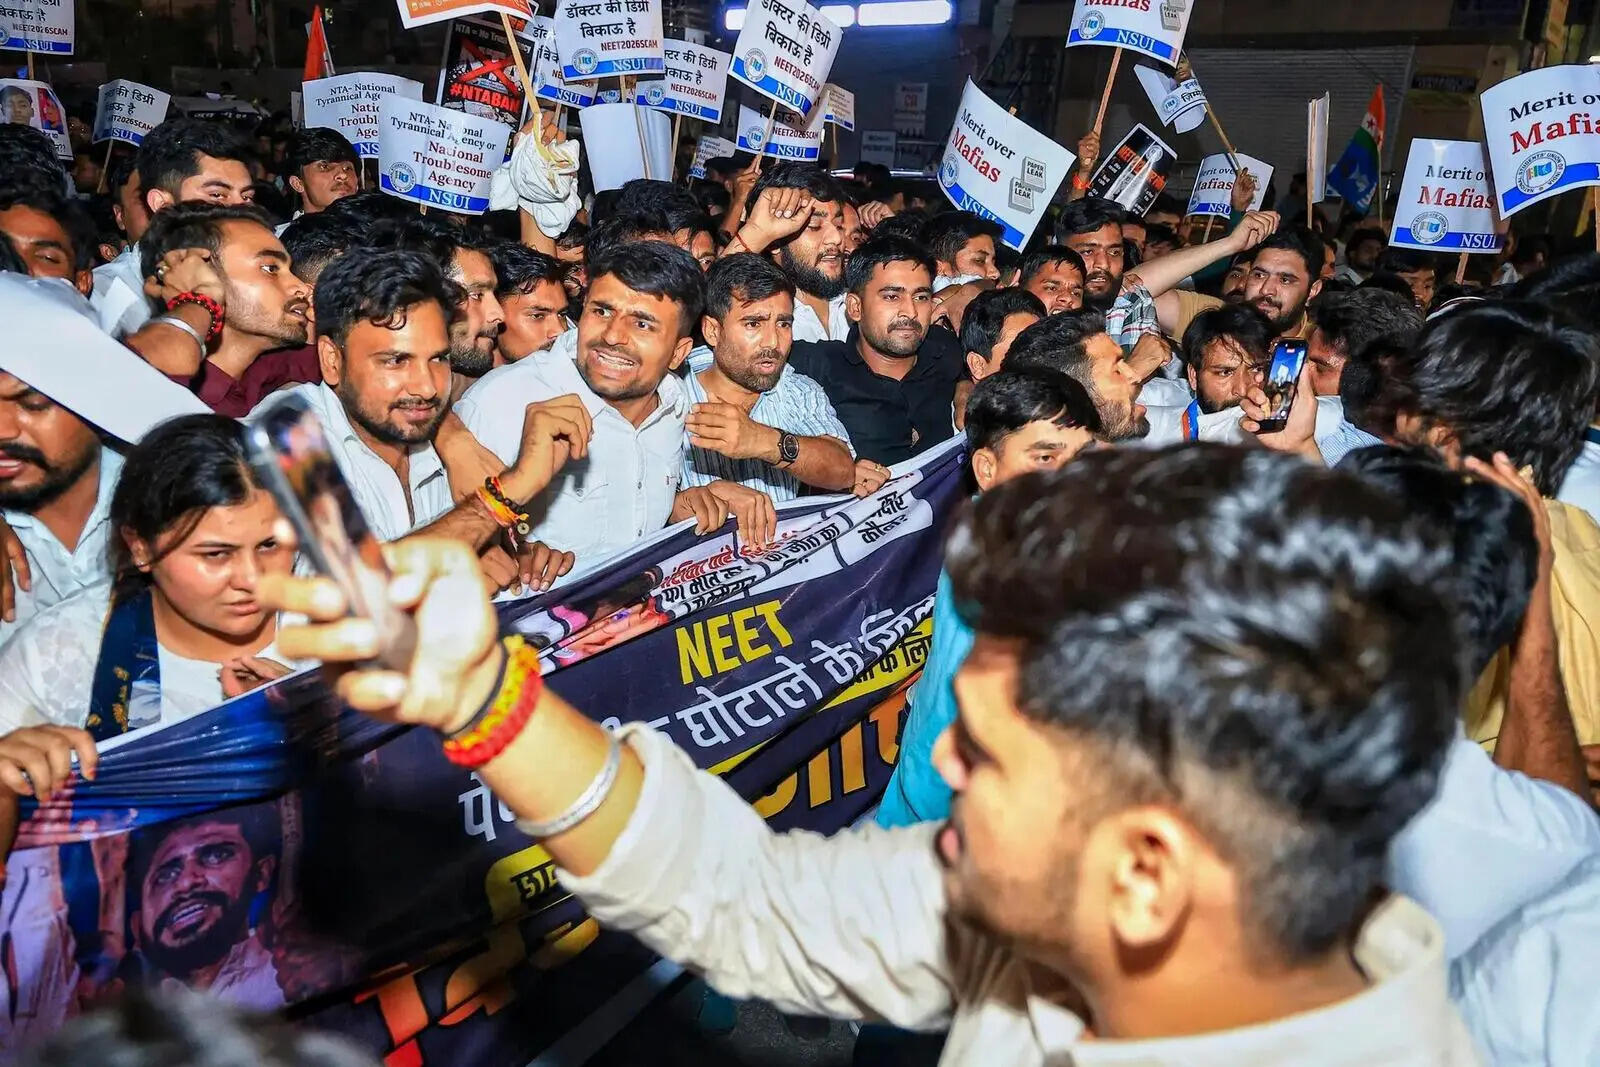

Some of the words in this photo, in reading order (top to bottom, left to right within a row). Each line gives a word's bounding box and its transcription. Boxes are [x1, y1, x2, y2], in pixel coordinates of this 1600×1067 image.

[565, 1, 601, 18] डॉक्टर
[580, 22, 623, 38] बिकाऊ
[626, 18, 636, 35] है
[797, 14, 811, 35] की
[811, 22, 832, 50] डिग्री
[23, 39, 54, 51] NSUI
[601, 39, 658, 51] NEET2026SCAM
[764, 20, 803, 59] बिकाऊ
[803, 44, 814, 67] है
[1117, 30, 1156, 52] NSUI
[612, 57, 647, 71] NSUI
[683, 50, 697, 65] की
[698, 53, 718, 71] डिग्री
[695, 70, 704, 85] है
[774, 56, 820, 91] NEET2026SCAM
[355, 83, 396, 94] National
[555, 88, 581, 104] NSUI
[671, 83, 717, 101] NEET2026SCAM
[776, 82, 807, 110] NSUI
[132, 89, 156, 106] डिग्री
[316, 92, 362, 107] Tyrannical
[448, 82, 521, 113] #NTABAN
[674, 100, 703, 116] NSUI
[1509, 91, 1577, 122] Merit
[1583, 93, 1600, 105] ov
[339, 115, 379, 127] Troubl
[409, 111, 435, 125] NTA-
[438, 119, 483, 138] Naonal
[112, 128, 137, 140] SUI
[356, 128, 378, 139] Age
[391, 116, 445, 139] Tyrannical
[486, 142, 497, 151] or
[772, 127, 819, 140] NEET2026SCAM
[961, 108, 987, 140] Merit
[987, 135, 1016, 160] over
[1510, 113, 1600, 155] Mafi
[360, 143, 379, 155] NS
[777, 145, 807, 159] NSUI
[952, 128, 1002, 184] Mafias
[413, 151, 492, 179] Troublesome
[1026, 168, 1043, 179] LEAK
[1027, 160, 1044, 171] PAPER
[1200, 167, 1216, 178] erit
[1218, 168, 1235, 176] ove
[1425, 165, 1473, 180] Merit
[428, 170, 476, 193] Agency
[1199, 177, 1234, 191] afias
[428, 189, 471, 210] NSUI
[1014, 188, 1031, 200] LEAK
[1417, 186, 1494, 209] Mafias
[1208, 202, 1231, 215] NSU
[1460, 233, 1496, 249] NSUI
[675, 600, 793, 685] NEET
[675, 655, 824, 748] घोटाले
[810, 639, 864, 685] के
